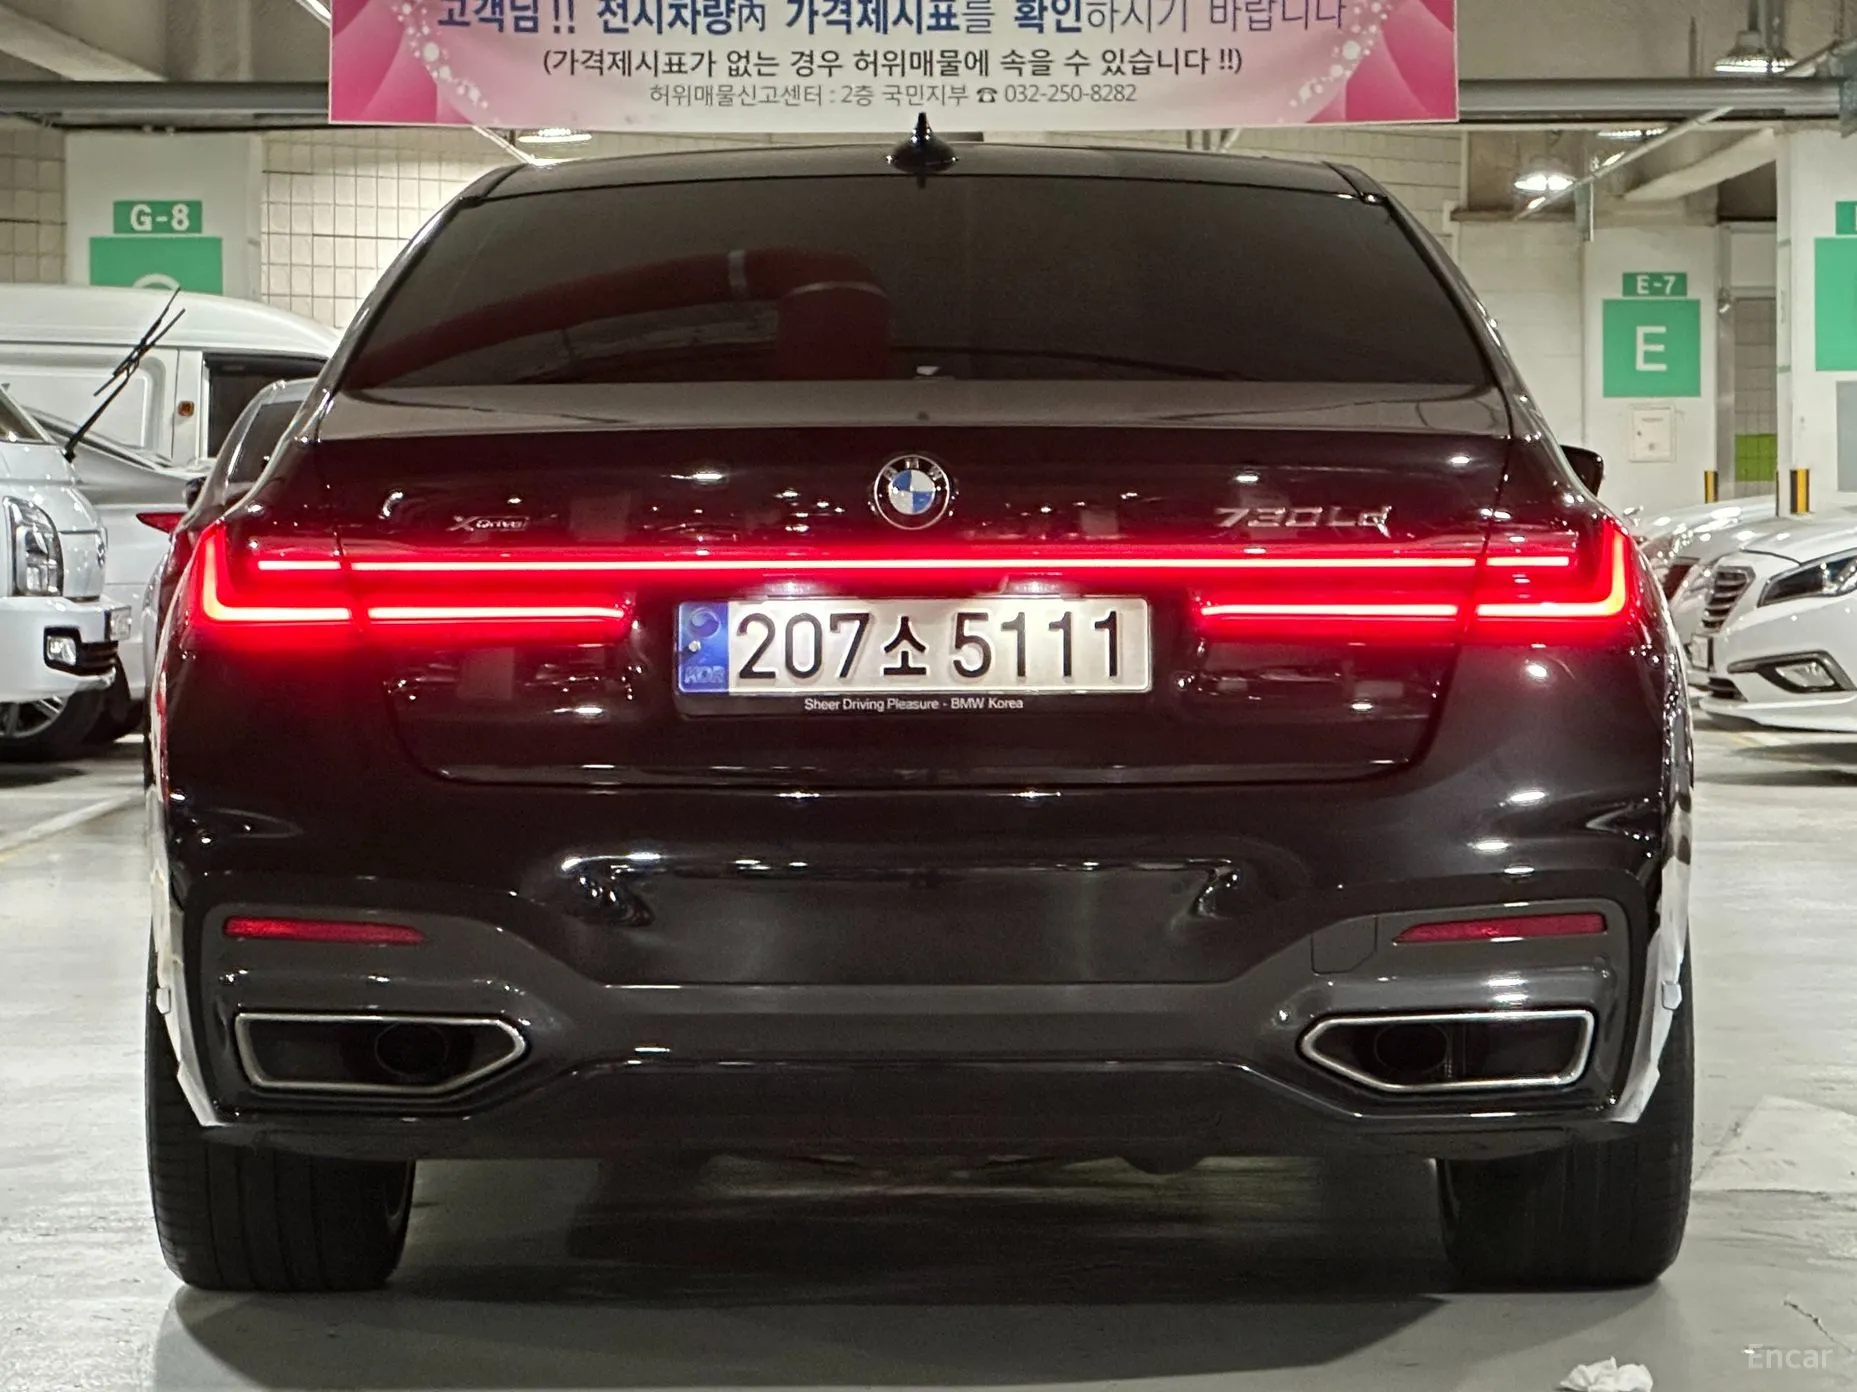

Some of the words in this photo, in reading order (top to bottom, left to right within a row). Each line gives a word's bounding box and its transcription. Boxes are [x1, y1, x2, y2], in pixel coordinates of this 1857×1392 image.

[785, 0, 995, 35] 가격제시표를
[1014, 0, 1188, 34] 확인하시기
[1210, 0, 1347, 33] 바랍니다
[543, 48, 717, 77] (가격제시표가
[727, 50, 780, 77] 없는
[791, 49, 843, 77] 경우
[853, 49, 989, 77] 허위매물에
[1000, 48, 1054, 77] 속을
[1063, 49, 1091, 77] 수
[882, 84, 968, 107] 국민지부
[1004, 84, 1137, 102] 032-250-8282
[129, 203, 190, 232] G-8
[1636, 274, 1676, 295] E-7
[1635, 326, 1667, 371] E
[804, 697, 840, 711] Sheer
[843, 697, 885, 712] Driving
[887, 697, 940, 711] Pleasure
[951, 697, 985, 710] BMW
[988, 697, 1024, 710] Korea
